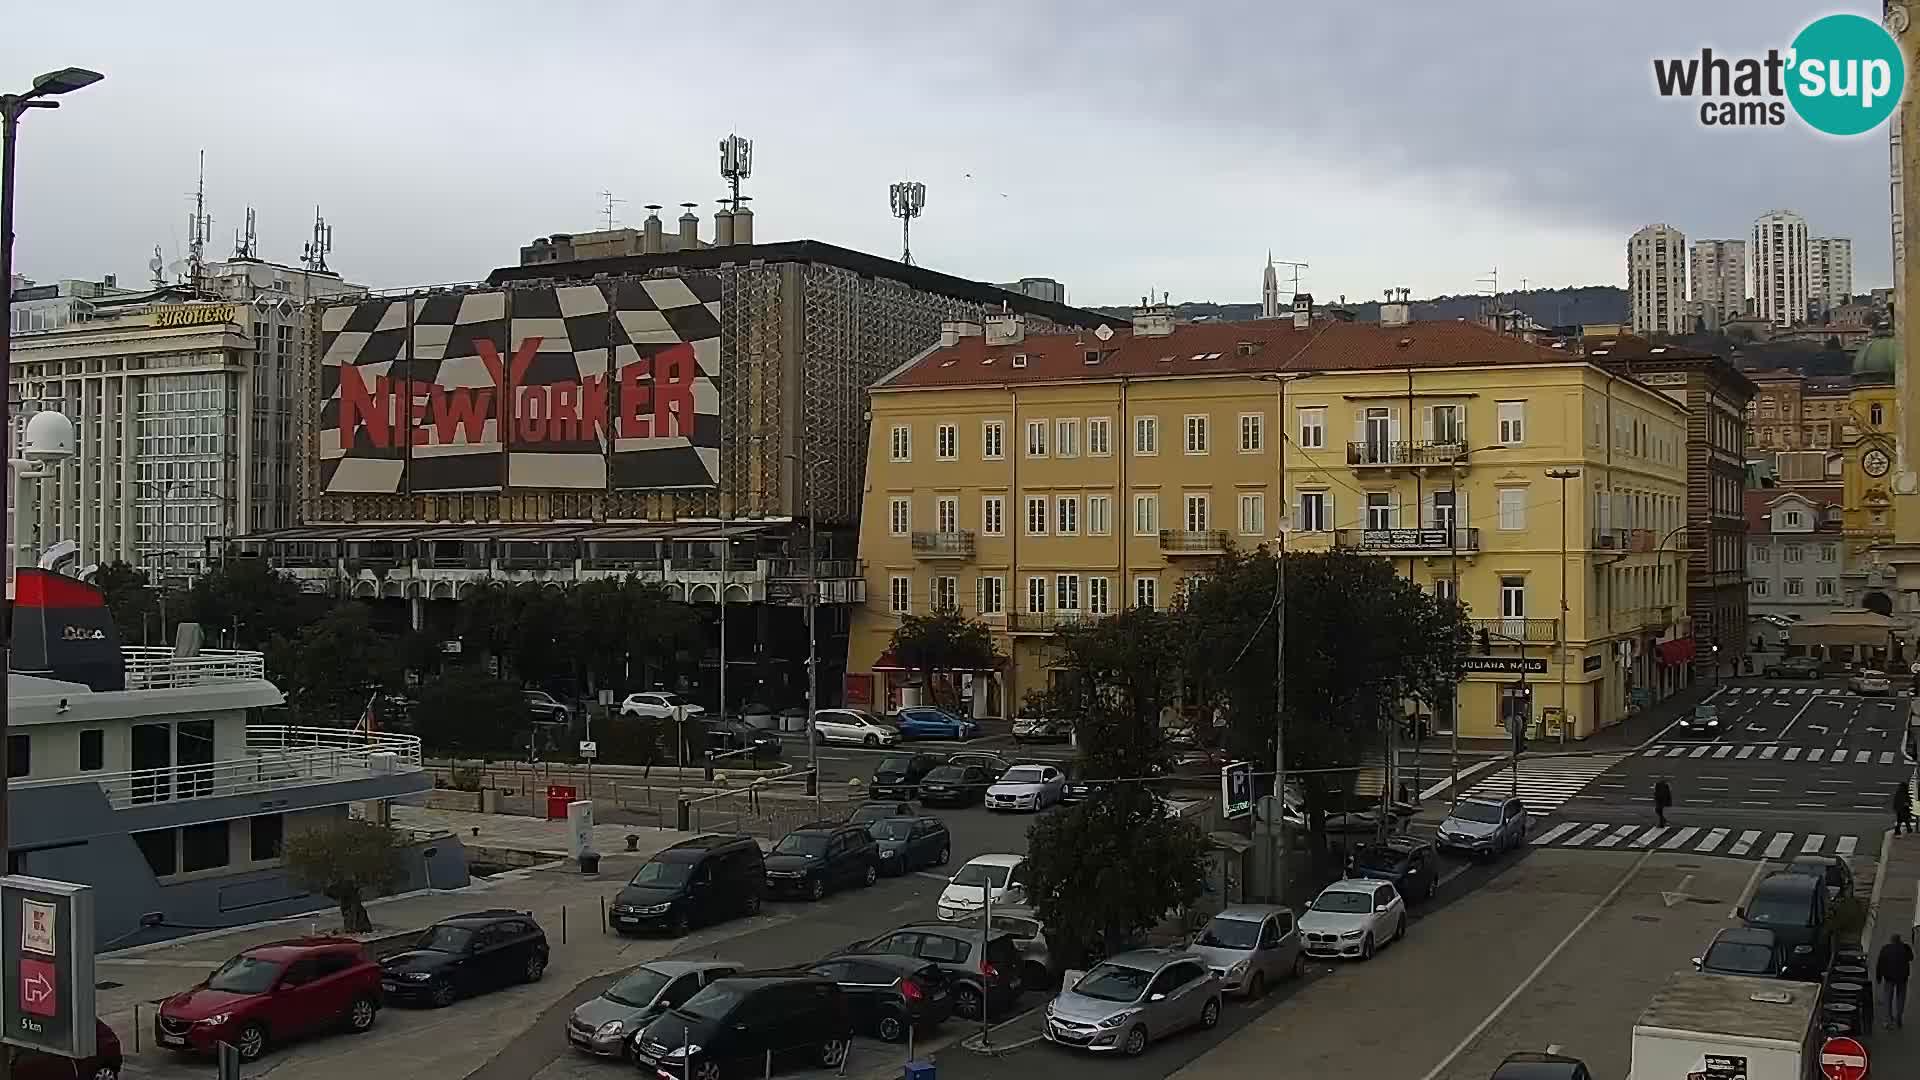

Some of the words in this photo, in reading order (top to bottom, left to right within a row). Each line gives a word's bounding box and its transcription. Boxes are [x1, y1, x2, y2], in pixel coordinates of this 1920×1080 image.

[1460, 661, 1505, 669] JULIANA
[22, 1018, 28, 1029] 5
[28, 1019, 42, 1033] km
